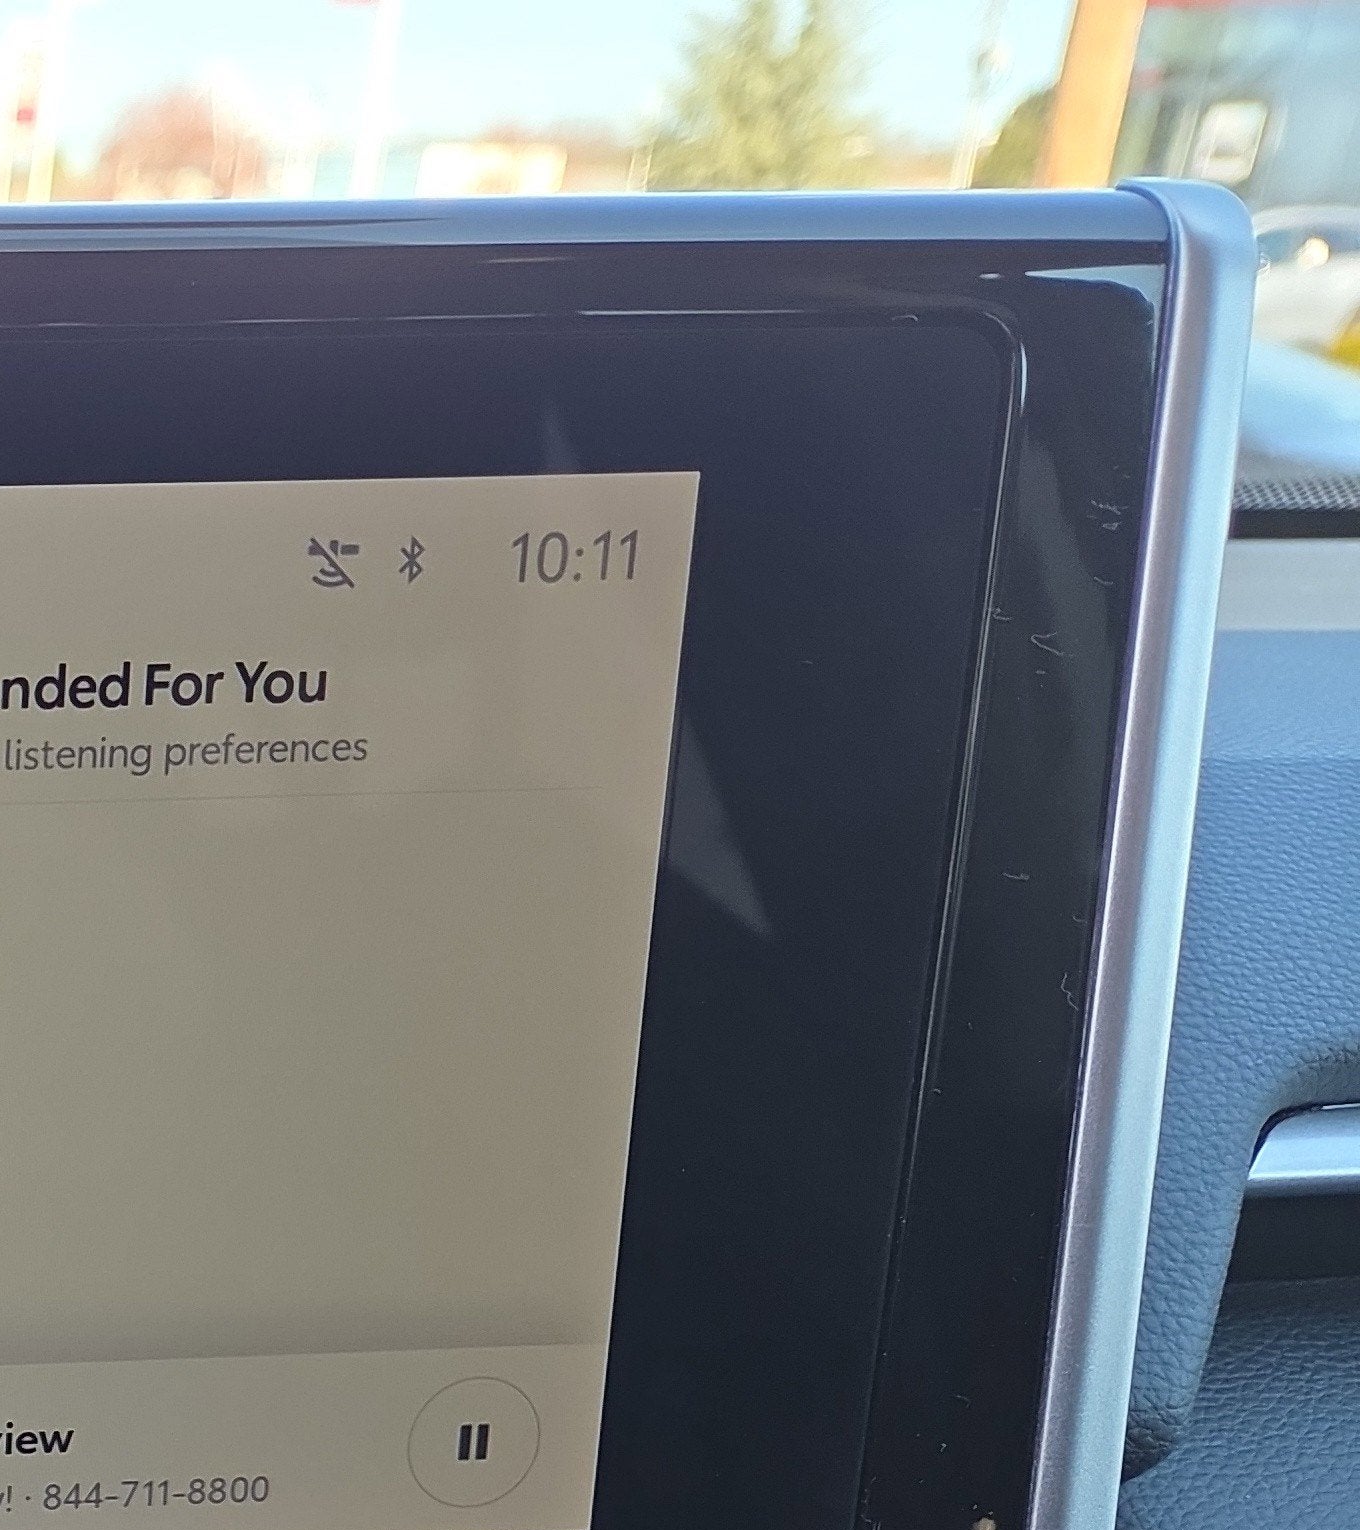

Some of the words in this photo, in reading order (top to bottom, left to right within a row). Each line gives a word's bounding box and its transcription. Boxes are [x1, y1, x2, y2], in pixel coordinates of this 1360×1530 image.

[512, 529, 639, 584] 10:11
[144, 663, 225, 707] For
[235, 660, 327, 704] You
[5, 736, 152, 777] listening
[164, 732, 368, 776] preferences
[43, 1475, 270, 1511] 844-711-8800
